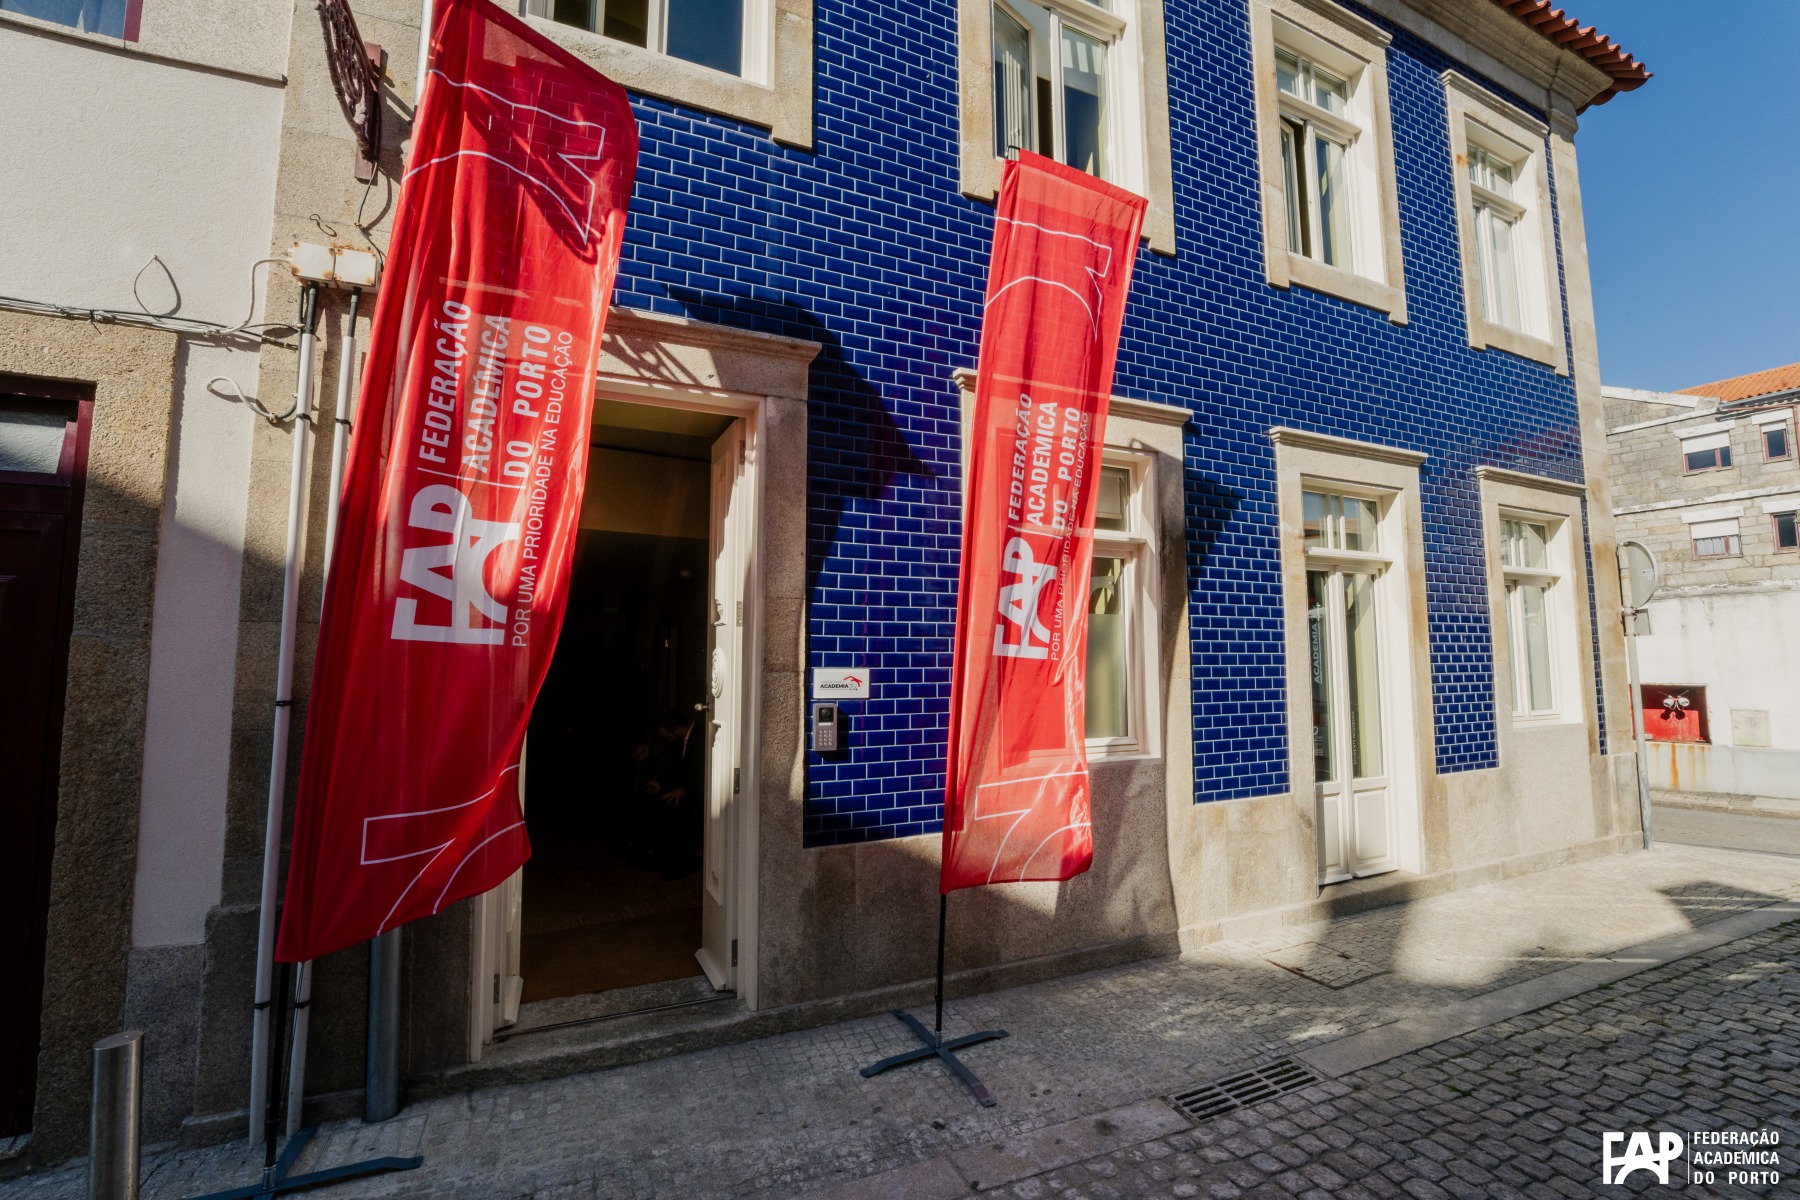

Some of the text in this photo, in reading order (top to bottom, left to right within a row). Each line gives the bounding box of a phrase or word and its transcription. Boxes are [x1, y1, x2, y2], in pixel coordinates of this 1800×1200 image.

[419, 300, 471, 463] FEDERAÇÃO
[464, 315, 511, 474] ACADÉMICA
[503, 325, 551, 480] DO PORTO
[1008, 393, 1032, 521] FEDERAÇÃO
[512, 331, 573, 647] POR UMA PRIORIDADE NA EDUCAÇÃO
[1027, 402, 1058, 527] ACADÉMICA
[1051, 412, 1088, 661] POR UMA PRIORIDADE NA EDUCAÇÃO
[1052, 407, 1080, 531] DO PORTO
[391, 483, 520, 646] FAP
[992, 536, 1058, 660] FAP
[1312, 623, 1320, 684] ACADEMIA
